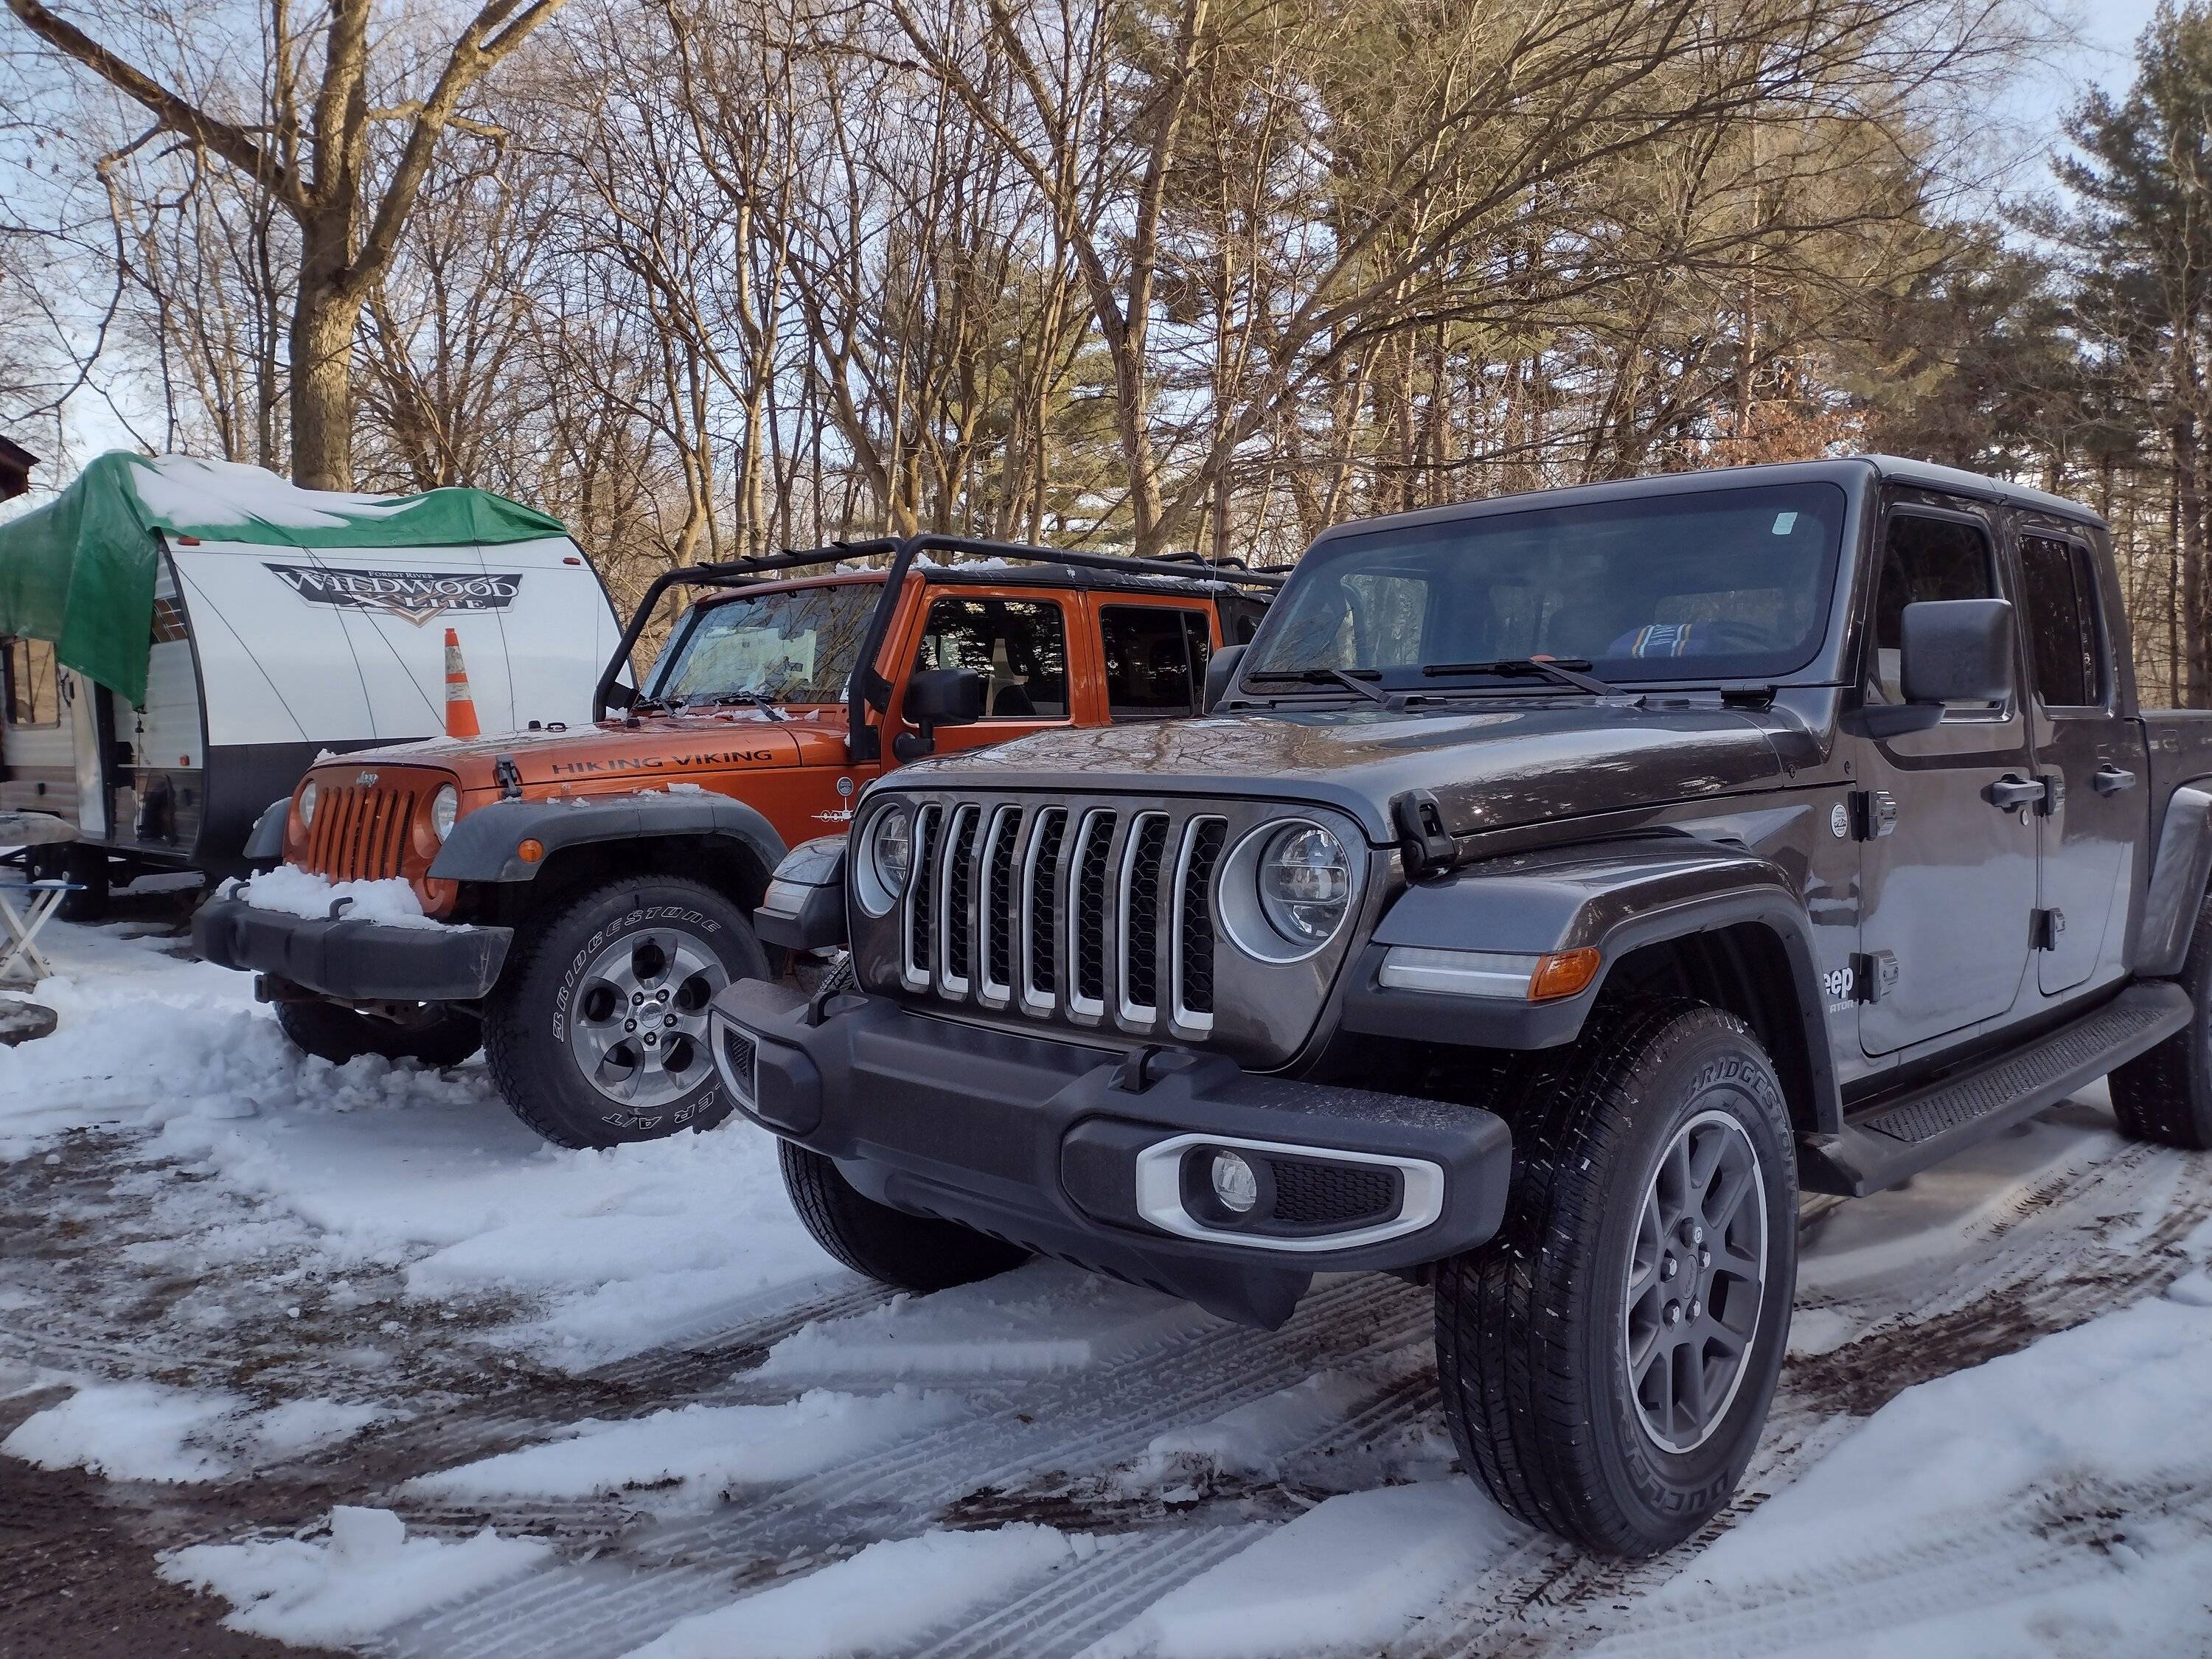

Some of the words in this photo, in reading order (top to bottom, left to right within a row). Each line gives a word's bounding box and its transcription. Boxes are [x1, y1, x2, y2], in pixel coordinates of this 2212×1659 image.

[272, 571, 518, 597] WILDWOOD
[367, 571, 404, 579] FOREST
[406, 571, 434, 580] RIVER
[404, 597, 486, 609] LITE
[552, 757, 664, 775] HIKING
[671, 749, 773, 766] VIKING
[552, 906, 721, 1043] BRIDGESTONE
[1823, 967, 1854, 999] eep
[1829, 999, 1854, 1014] ATOR
